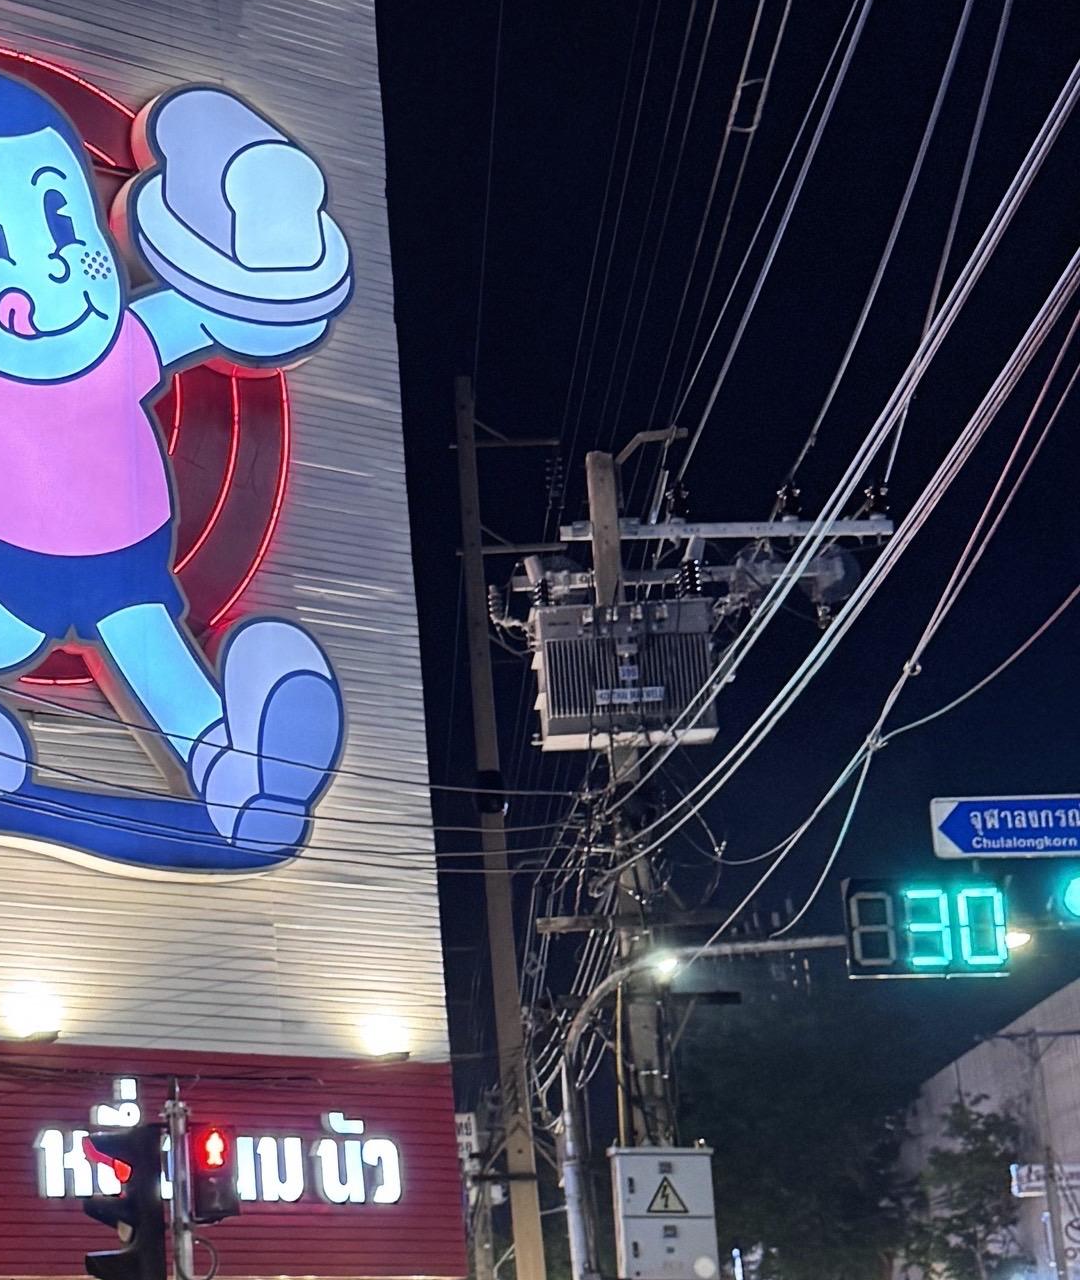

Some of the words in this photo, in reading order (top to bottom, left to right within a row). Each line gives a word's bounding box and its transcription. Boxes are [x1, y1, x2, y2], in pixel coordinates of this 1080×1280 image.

[972, 836, 1077, 850] Chulalongkorn
[906, 887, 1008, 966] 30
[317, 1111, 402, 1204] นัว
